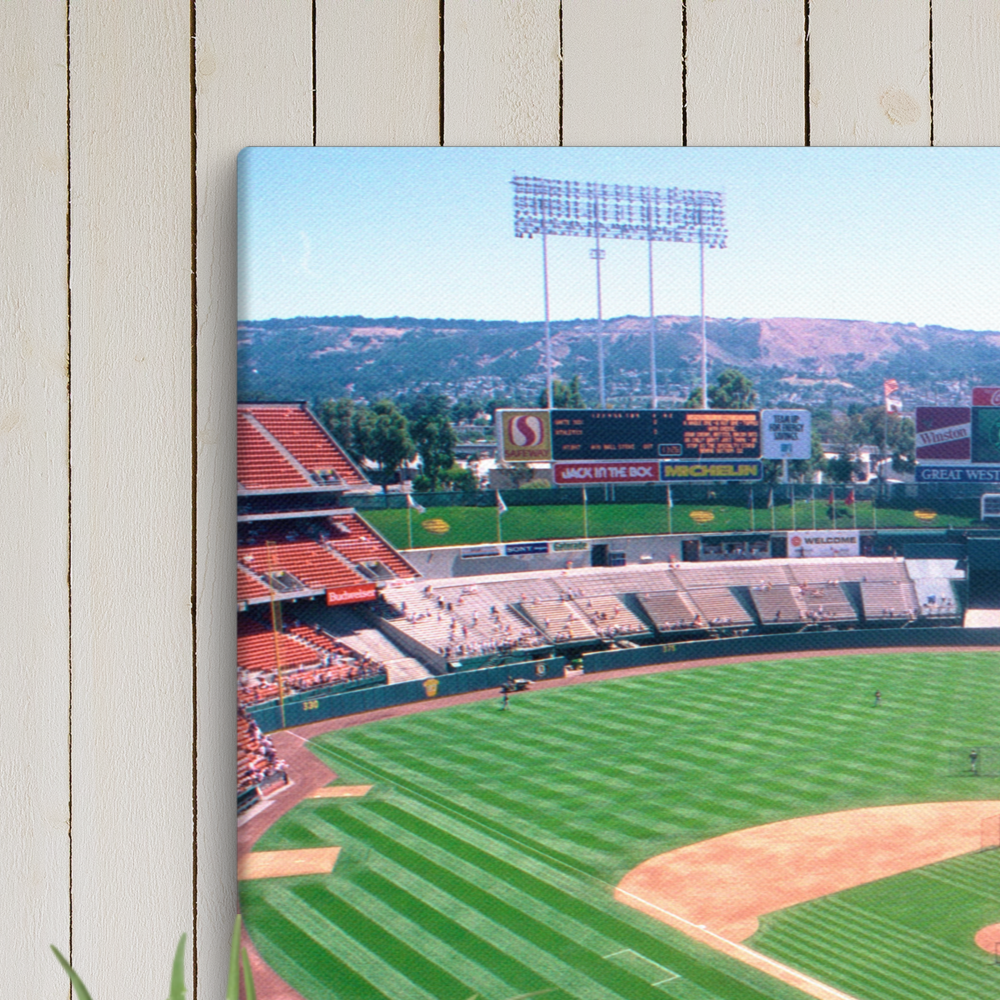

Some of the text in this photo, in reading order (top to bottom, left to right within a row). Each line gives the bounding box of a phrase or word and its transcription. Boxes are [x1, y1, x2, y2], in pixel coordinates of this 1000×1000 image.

[920, 428, 968, 444] Winston
[505, 449, 549, 458] SAFEWAY
[562, 467, 593, 479] JACK
[608, 466, 627, 478] THE
[629, 466, 654, 478] BOX
[664, 464, 759, 477] MICHELIN
[921, 469, 964, 480] GREAT
[804, 536, 857, 545] WELCOME
[328, 589, 377, 603] Budweiser
